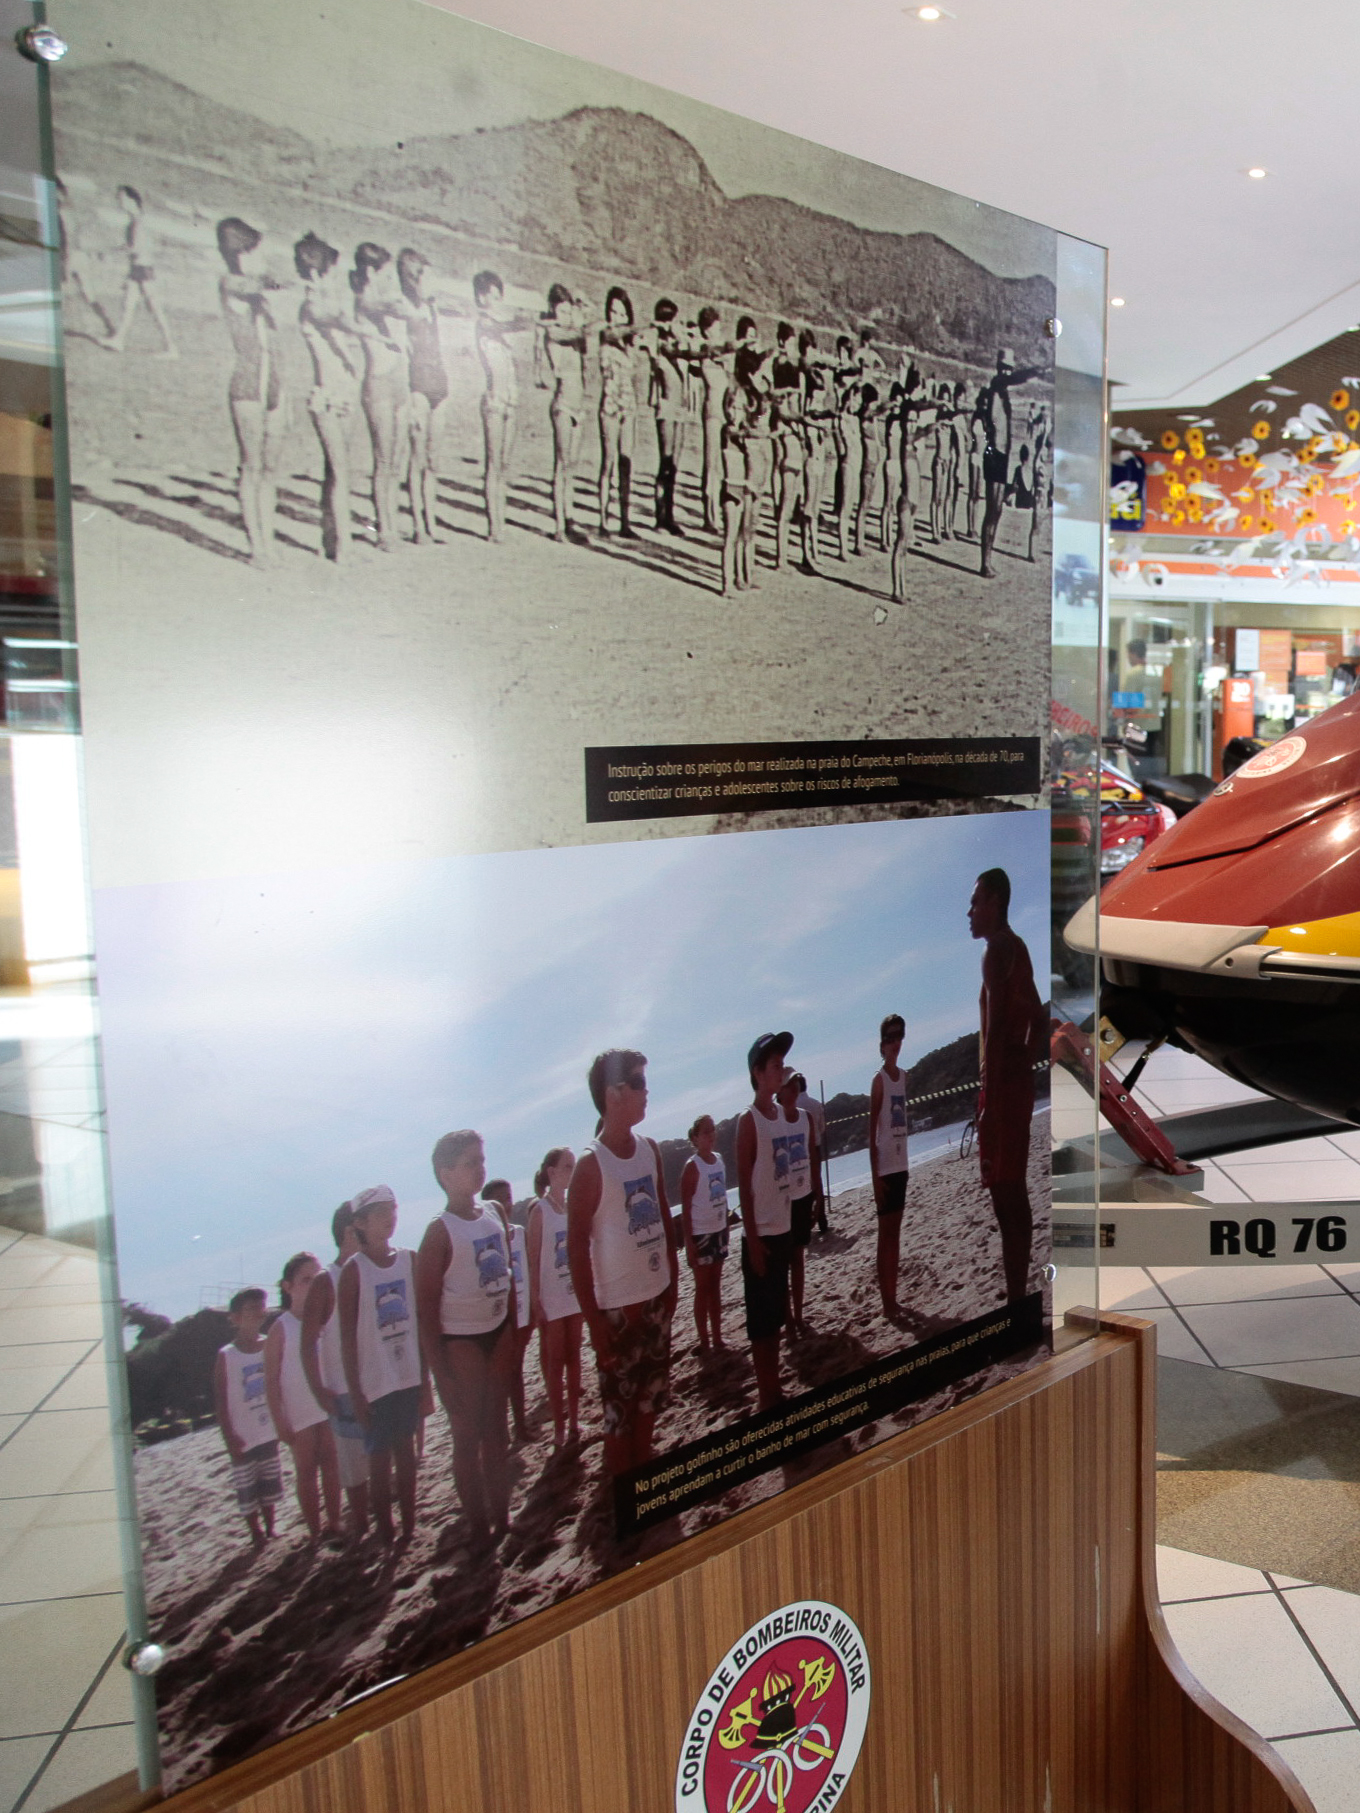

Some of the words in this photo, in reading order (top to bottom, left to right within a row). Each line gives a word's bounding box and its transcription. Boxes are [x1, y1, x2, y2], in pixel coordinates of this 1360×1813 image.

[607, 762, 654, 780] Instrução
[656, 762, 682, 776] sobre
[685, 764, 697, 775] os
[698, 759, 732, 779] perigos
[733, 759, 746, 772] do
[747, 760, 765, 771] mar
[766, 757, 804, 771] realizada
[806, 758, 817, 770] na
[818, 756, 838, 771] praia
[840, 755, 850, 768] do
[852, 753, 893, 769] Campeche,
[894, 756, 906, 766] em
[955, 754, 963, 764] na
[965, 751, 988, 763] década
[989, 751, 998, 762] de
[608, 786, 673, 802] conscientizar
[674, 783, 713, 800] crianças
[714, 786, 720, 796] e
[722, 781, 779, 796] adolescentes
[780, 778, 804, 792] sobre
[806, 779, 815, 790] os
[817, 777, 840, 789] riscos
[841, 775, 851, 788] de
[853, 774, 899, 791] afogamento.
[1210, 1218, 1276, 1258] RQ
[1292, 1215, 1347, 1253] 76
[635, 1480, 650, 1494] No
[651, 1463, 685, 1490] projeto
[686, 1446, 723, 1474] golfinho
[725, 1439, 740, 1455] são
[742, 1420, 784, 1446] oferecidas
[785, 1401, 826, 1426] atividades
[827, 1382, 866, 1407] educativas
[868, 1377, 878, 1389] de
[879, 1361, 914, 1385] segurança
[915, 1355, 928, 1368] nas
[951, 1338, 966, 1354] para
[967, 1332, 979, 1346] que
[980, 1321, 1006, 1339] crianças
[1006, 1318, 1011, 1327] e
[636, 1492, 667, 1519] jovens
[669, 1469, 714, 1502] aprendam
[715, 1468, 721, 1479] a
[723, 1456, 746, 1475] curtir
[748, 1453, 755, 1464] o
[756, 1440, 782, 1460] banho
[783, 1434, 794, 1448] de
[795, 1427, 811, 1441] mar
[812, 1419, 829, 1433] com
[830, 1401, 869, 1426] segurança.
[681, 1708, 713, 1797] CORPO
[708, 1667, 734, 1704] DE
[732, 1608, 832, 1671] BOMBEIROS
[829, 1619, 866, 1694] MILITAR
